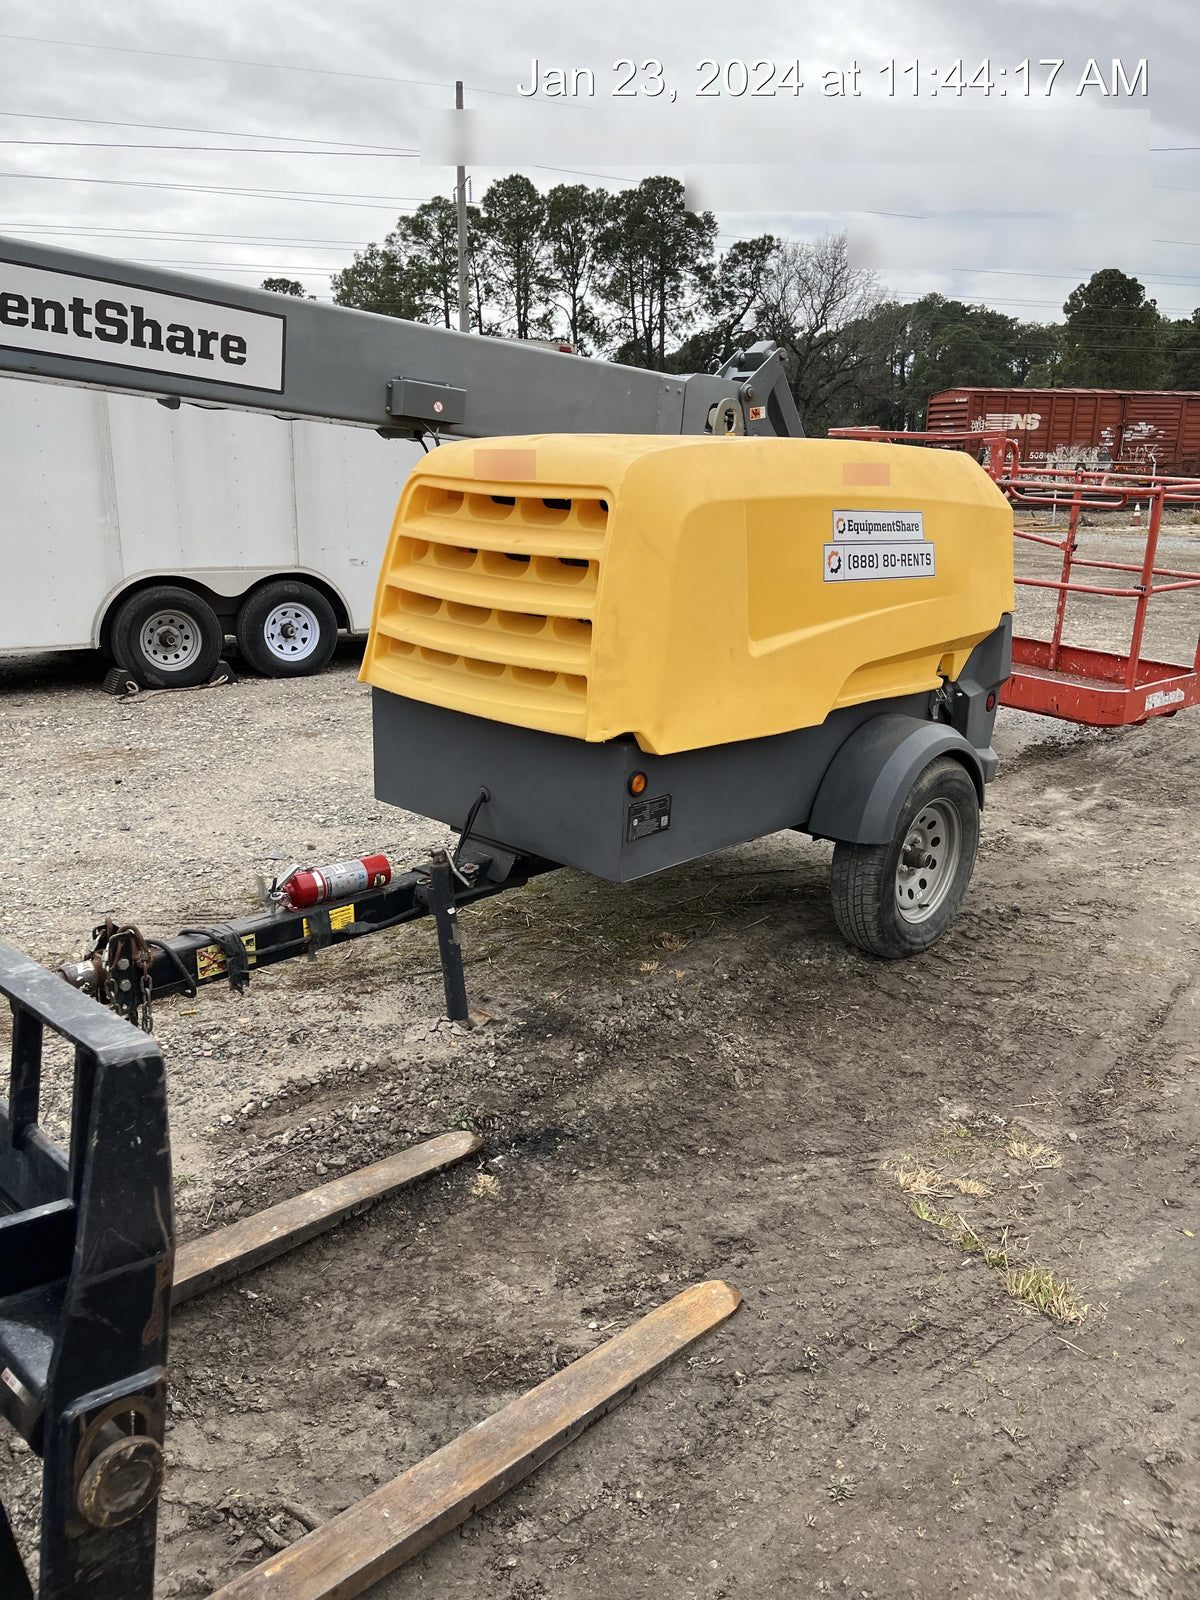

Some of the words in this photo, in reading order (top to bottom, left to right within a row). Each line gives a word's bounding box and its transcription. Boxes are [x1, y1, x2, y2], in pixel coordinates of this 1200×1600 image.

[0, 292, 247, 366] entShare
[1007, 413, 1041, 430] NS
[847, 520, 920, 534] EquipmentShare
[848, 553, 879, 570] (888)
[882, 553, 931, 568] 80-RENTS
